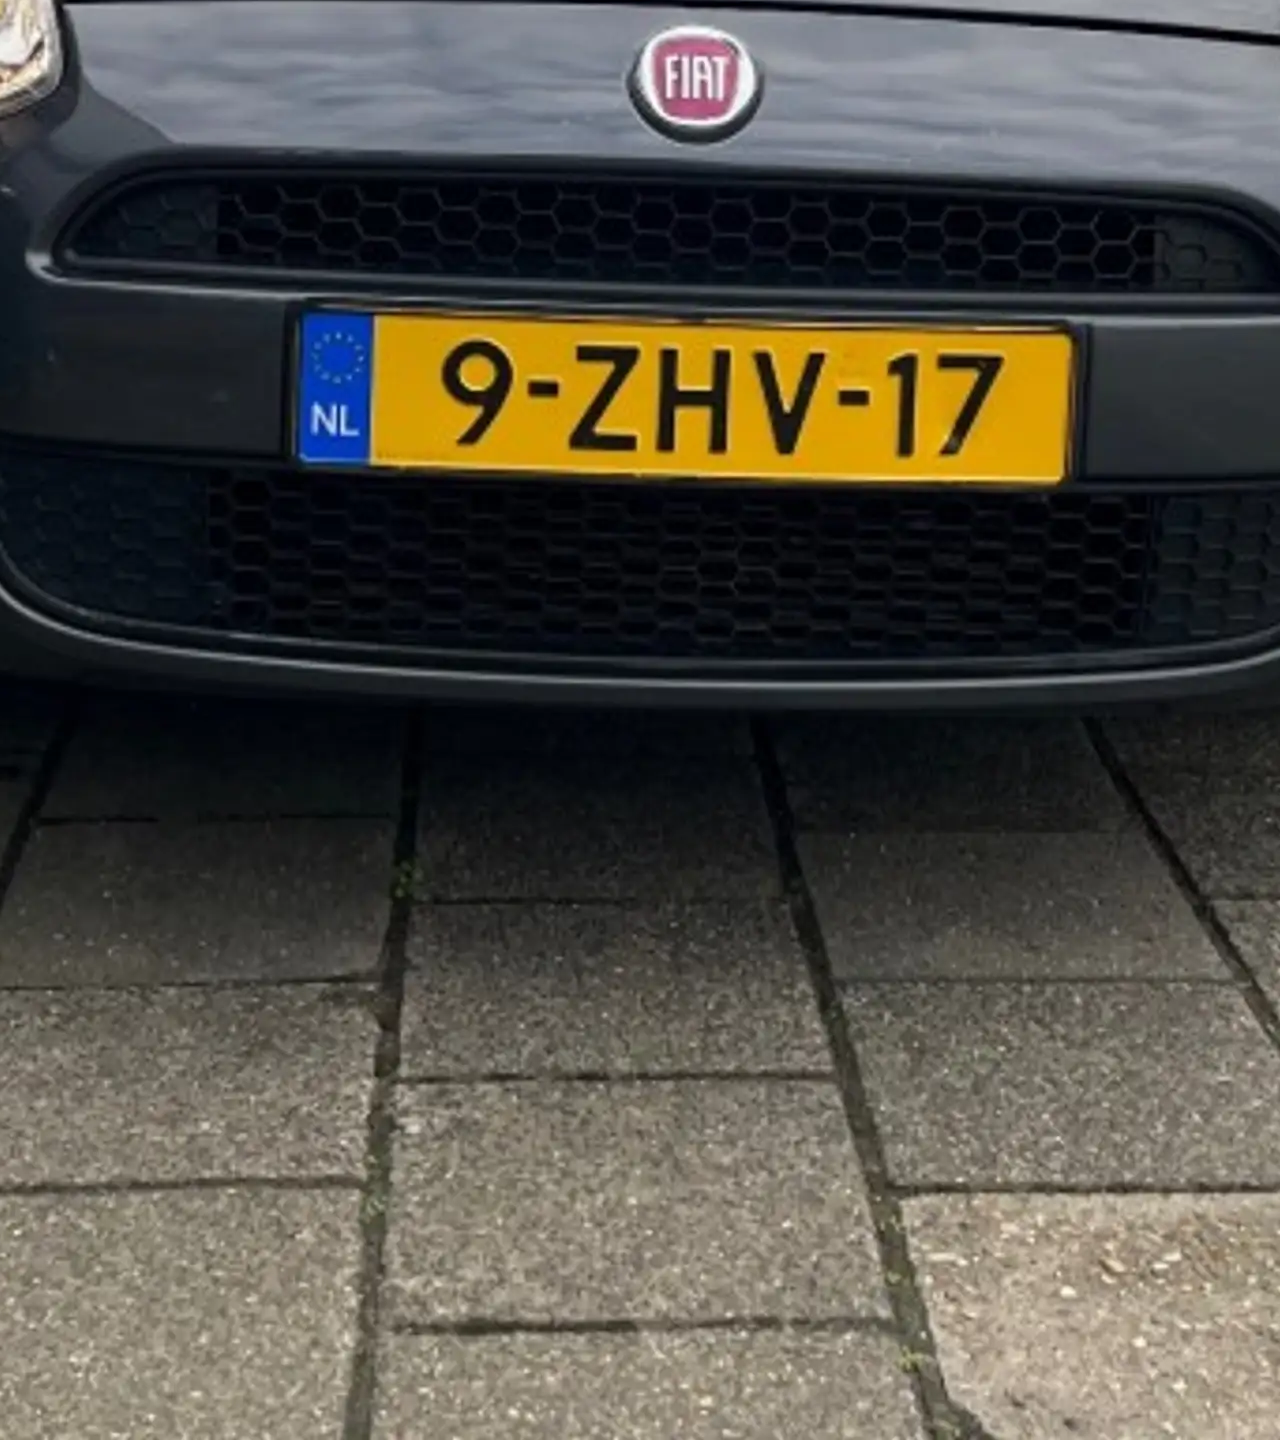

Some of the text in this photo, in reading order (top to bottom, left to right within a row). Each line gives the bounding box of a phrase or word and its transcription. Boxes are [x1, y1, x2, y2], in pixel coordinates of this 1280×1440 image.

[665, 56, 730, 101] FIAT
[310, 402, 359, 437] NL
[441, 339, 1005, 458] 9-ZHV-17
